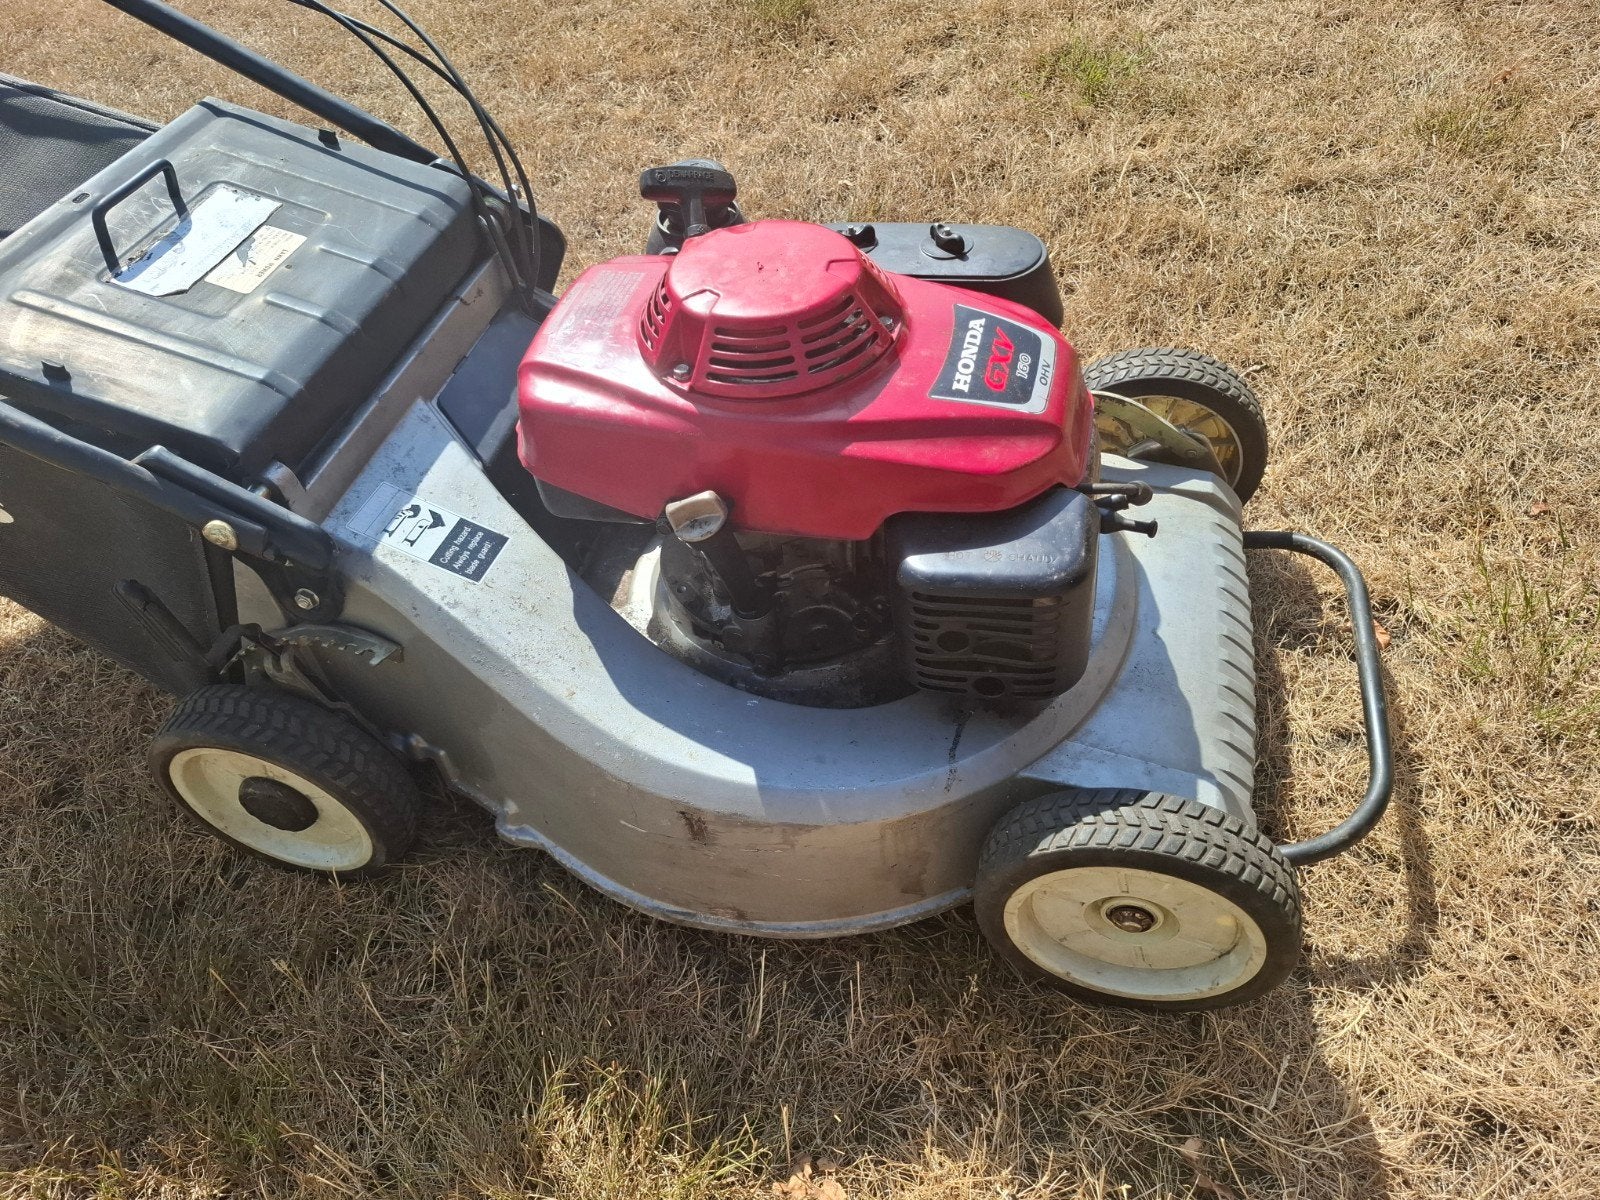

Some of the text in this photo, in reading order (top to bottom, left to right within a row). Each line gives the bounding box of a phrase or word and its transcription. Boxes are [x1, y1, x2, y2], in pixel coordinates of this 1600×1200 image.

[952, 318, 986, 393] HONDA
[984, 326, 1014, 392] GXV
[1015, 352, 1032, 379] 160
[1039, 359, 1051, 386] OHV
[440, 545, 460, 564] Cutting
[452, 531, 484, 570] Always replace
[464, 559, 480, 575] blade
